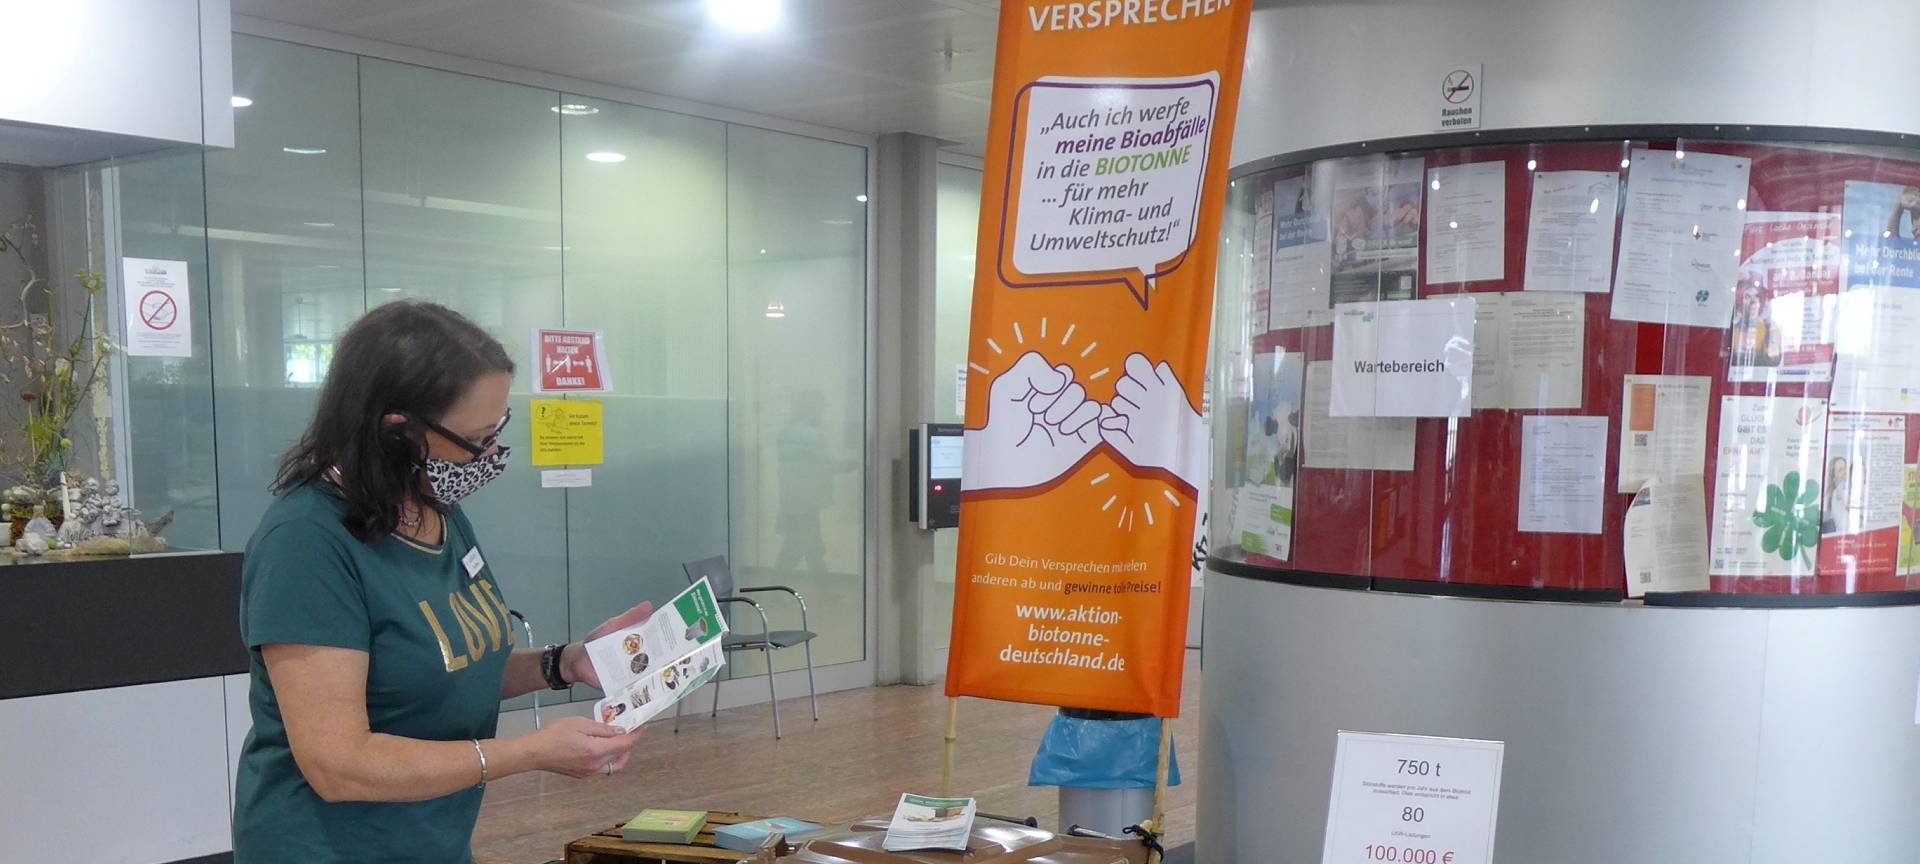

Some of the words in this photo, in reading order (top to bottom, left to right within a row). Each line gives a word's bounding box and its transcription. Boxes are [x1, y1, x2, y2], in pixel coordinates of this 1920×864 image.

[1105, 105, 1133, 126] ich
[1139, 96, 1190, 124] werfe
[1055, 134, 1116, 154] meine
[1120, 115, 1206, 148] Bioabfälle
[1036, 161, 1055, 180] in
[1060, 159, 1090, 178] die
[1094, 144, 1192, 176] BIOTONNE
[1058, 183, 1094, 208] für
[1097, 178, 1149, 200] mehr
[1068, 207, 1132, 226] Klima-
[1137, 197, 1174, 220] und
[1354, 359, 1445, 373] Wartebereich
[985, 552, 1006, 566] Gib
[1009, 555, 1038, 569] Dein
[1042, 558, 1110, 574] Versprechen
[971, 572, 1017, 587] anderen
[1021, 577, 1036, 589] ab
[1040, 579, 1062, 591] und
[1064, 581, 1112, 595] gewinne
[1016, 604, 1122, 625] www.aktion-
[1028, 624, 1110, 647] biotonne-
[1000, 644, 1125, 672] deutschland.de
[1397, 759, 1430, 776] 750
[1435, 762, 1442, 777] t
[1402, 807, 1424, 822] 80
[1366, 844, 1436, 864] 100.000
[1442, 851, 1454, 864] €
